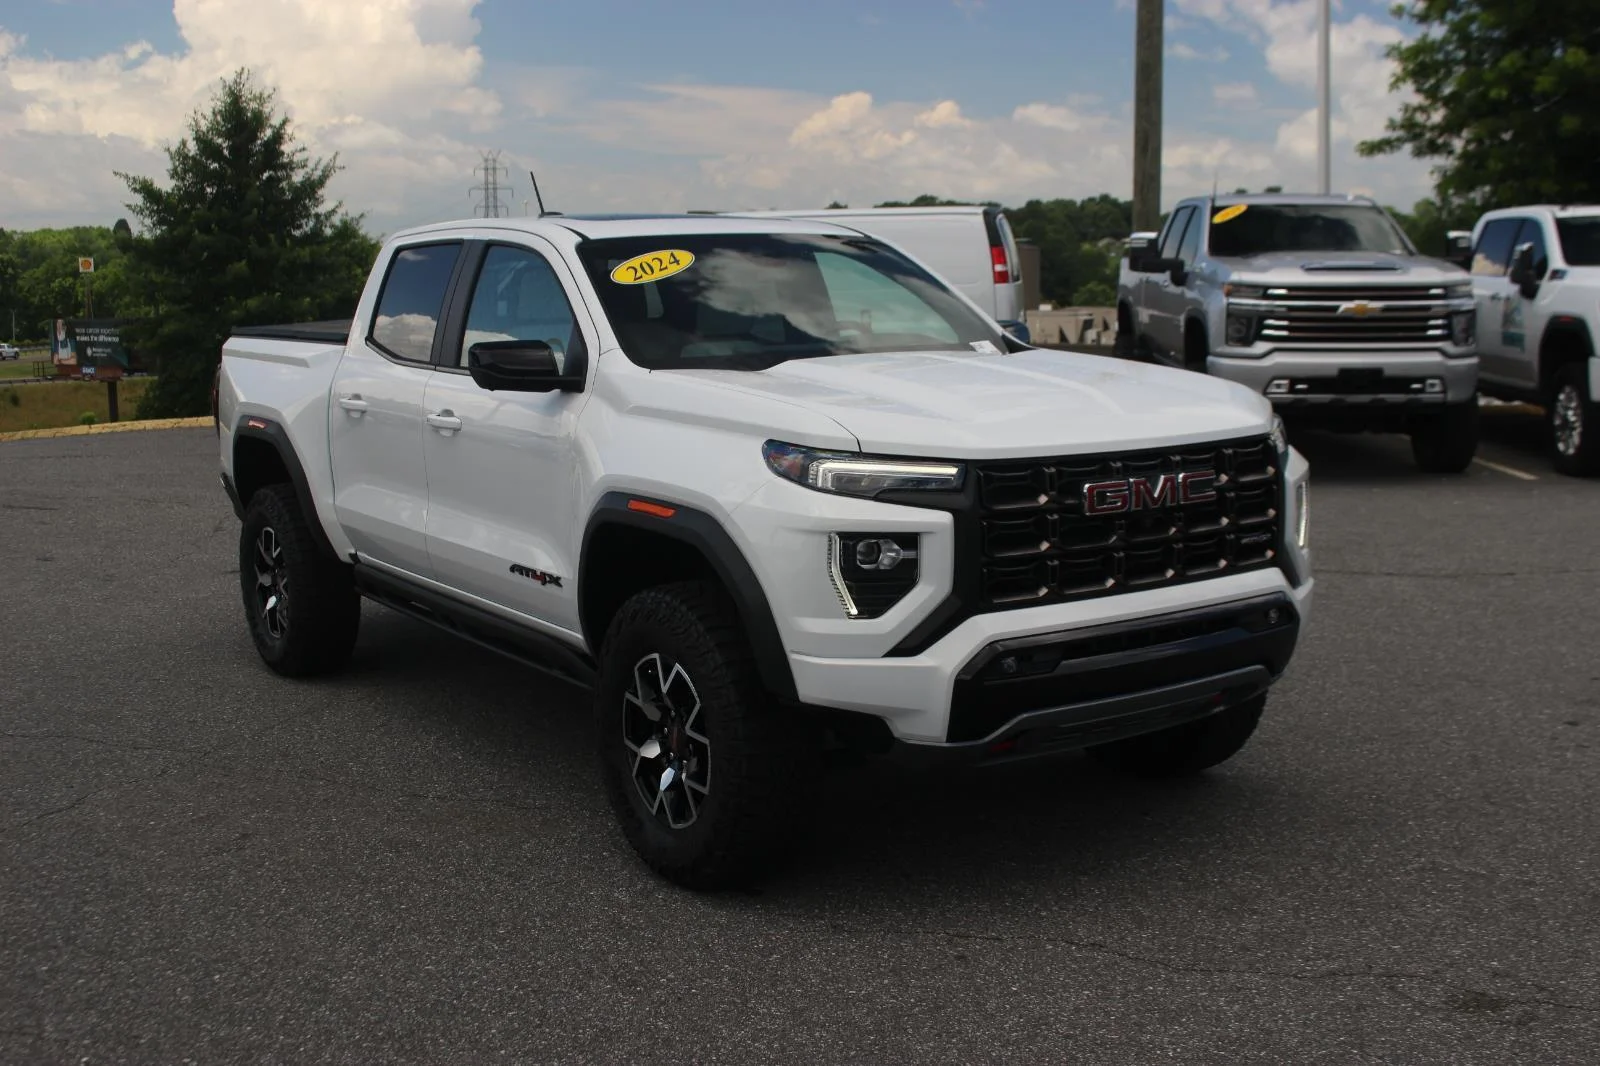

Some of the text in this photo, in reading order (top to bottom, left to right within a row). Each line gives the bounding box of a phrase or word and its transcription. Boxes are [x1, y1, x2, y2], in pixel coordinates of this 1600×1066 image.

[626, 252, 680, 281] 2024
[1083, 470, 1216, 515] GMC
[509, 563, 563, 588] AT4X
